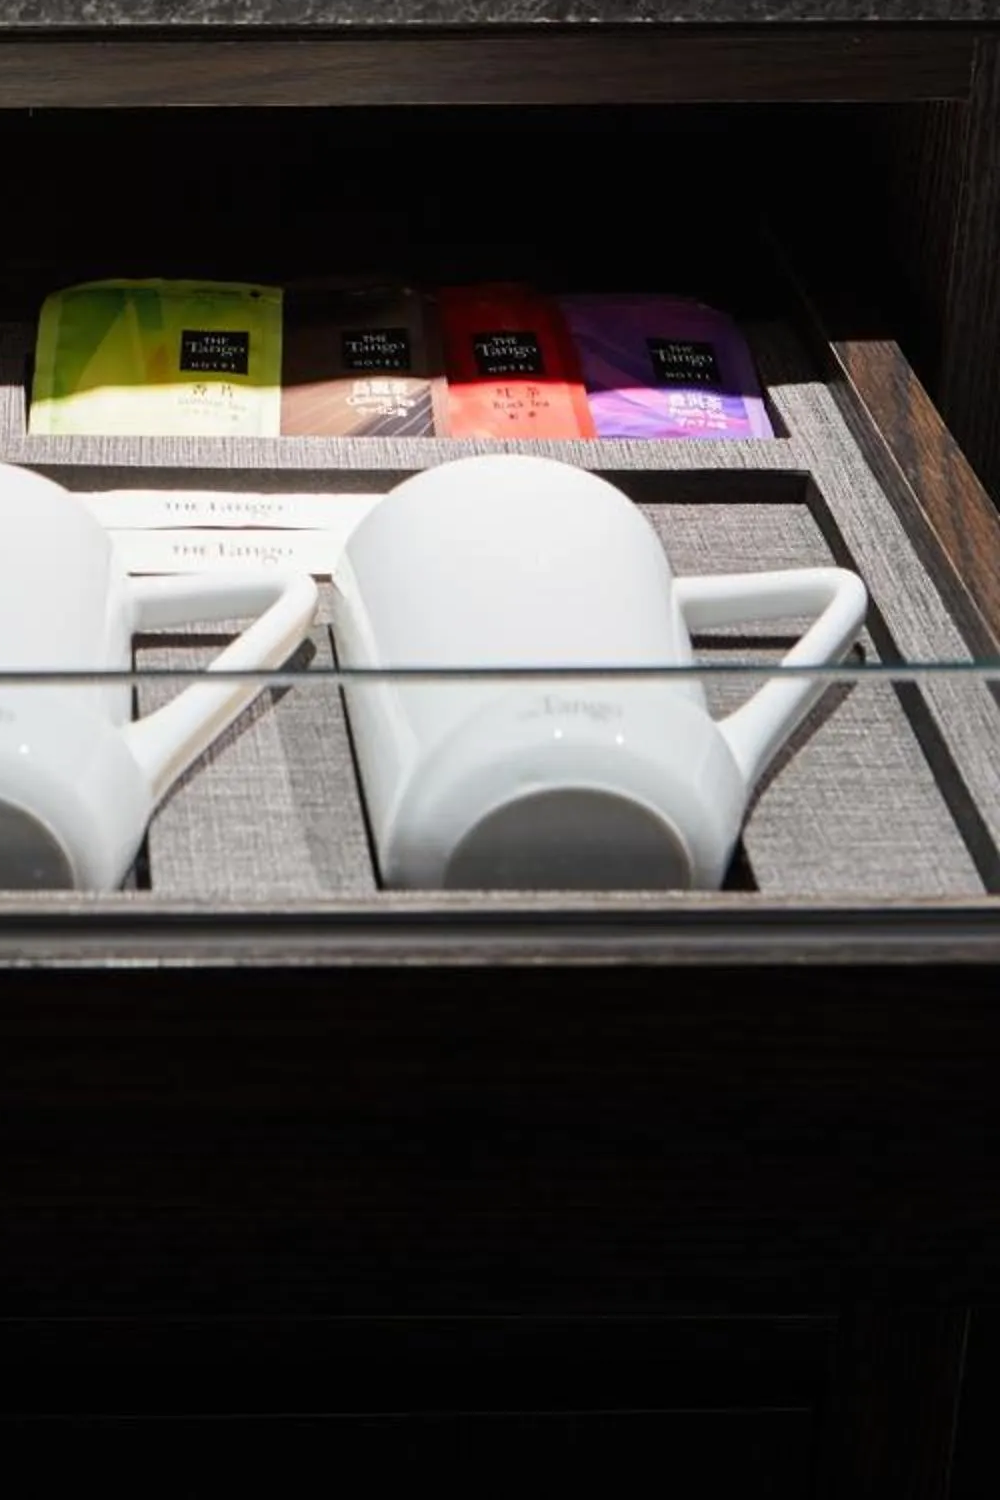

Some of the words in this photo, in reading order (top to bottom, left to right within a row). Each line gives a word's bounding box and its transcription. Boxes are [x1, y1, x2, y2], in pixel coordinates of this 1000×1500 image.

[185, 340, 245, 357] Tango
[345, 340, 405, 355] Tango
[475, 343, 537, 359] Tango
[650, 349, 713, 368] Tango
